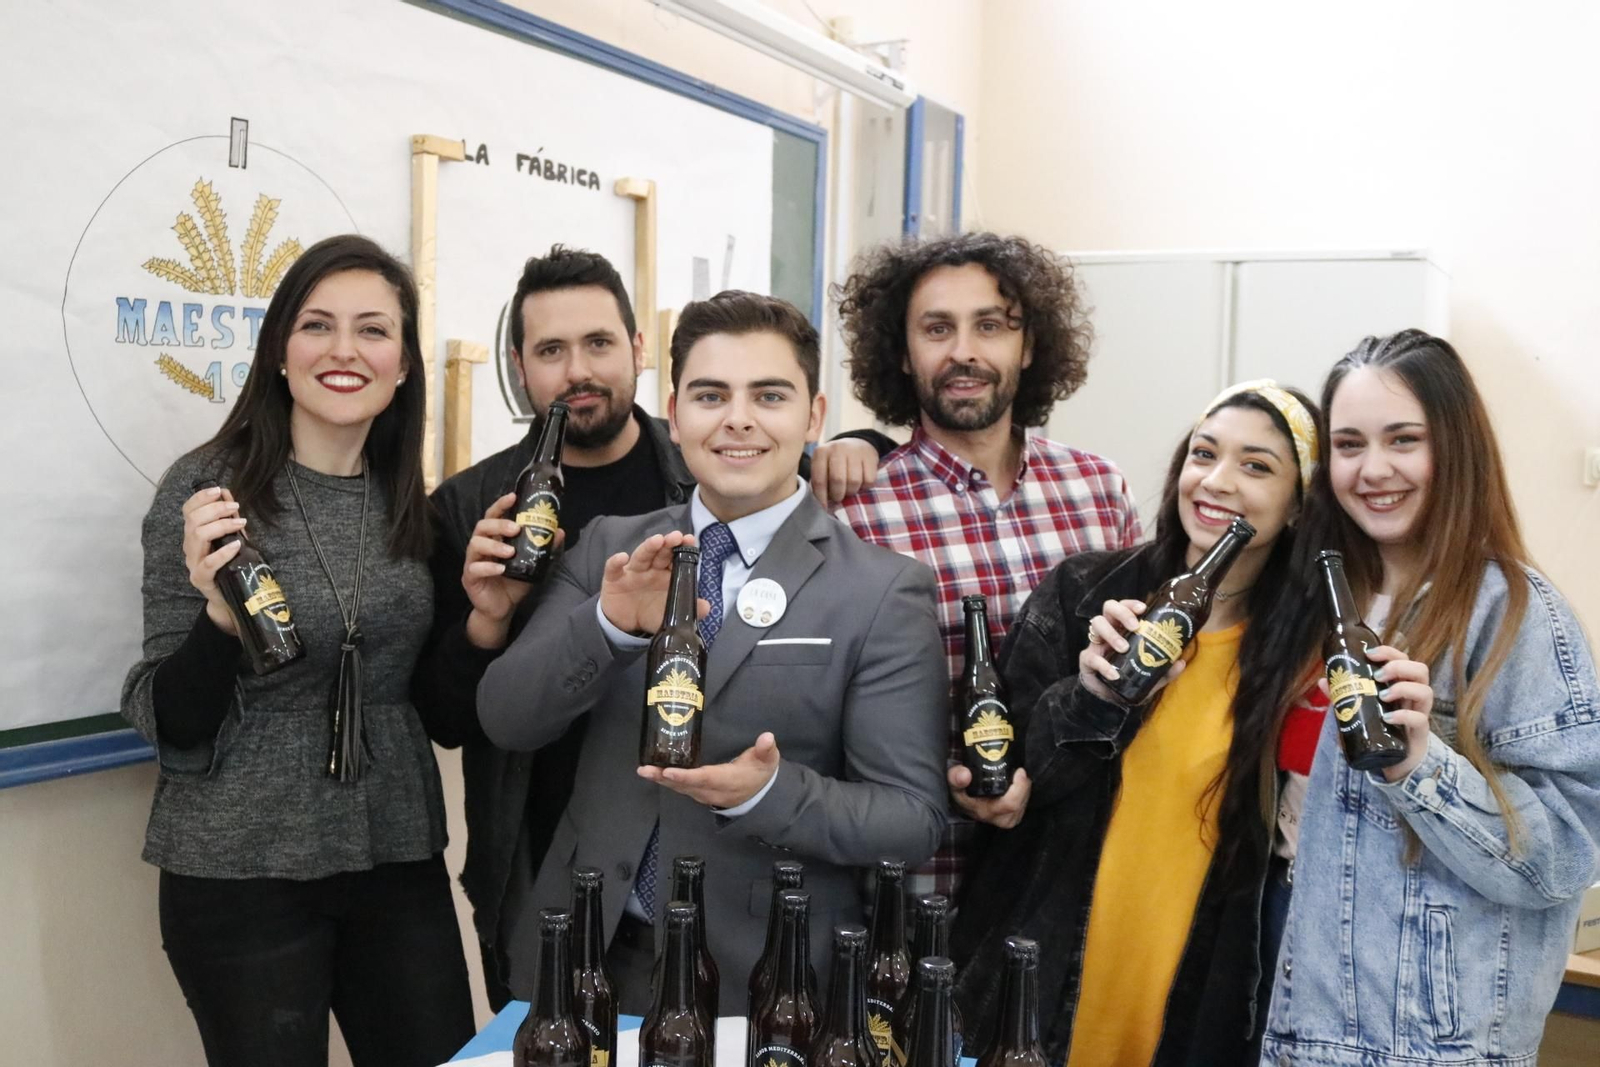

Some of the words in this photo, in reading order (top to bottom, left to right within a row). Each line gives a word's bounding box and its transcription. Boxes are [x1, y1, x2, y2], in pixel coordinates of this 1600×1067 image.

[516, 147, 600, 191] FÁBRICA
[115, 297, 266, 351] MAEST
[768, 1045, 805, 1065] MEDITERRAN
